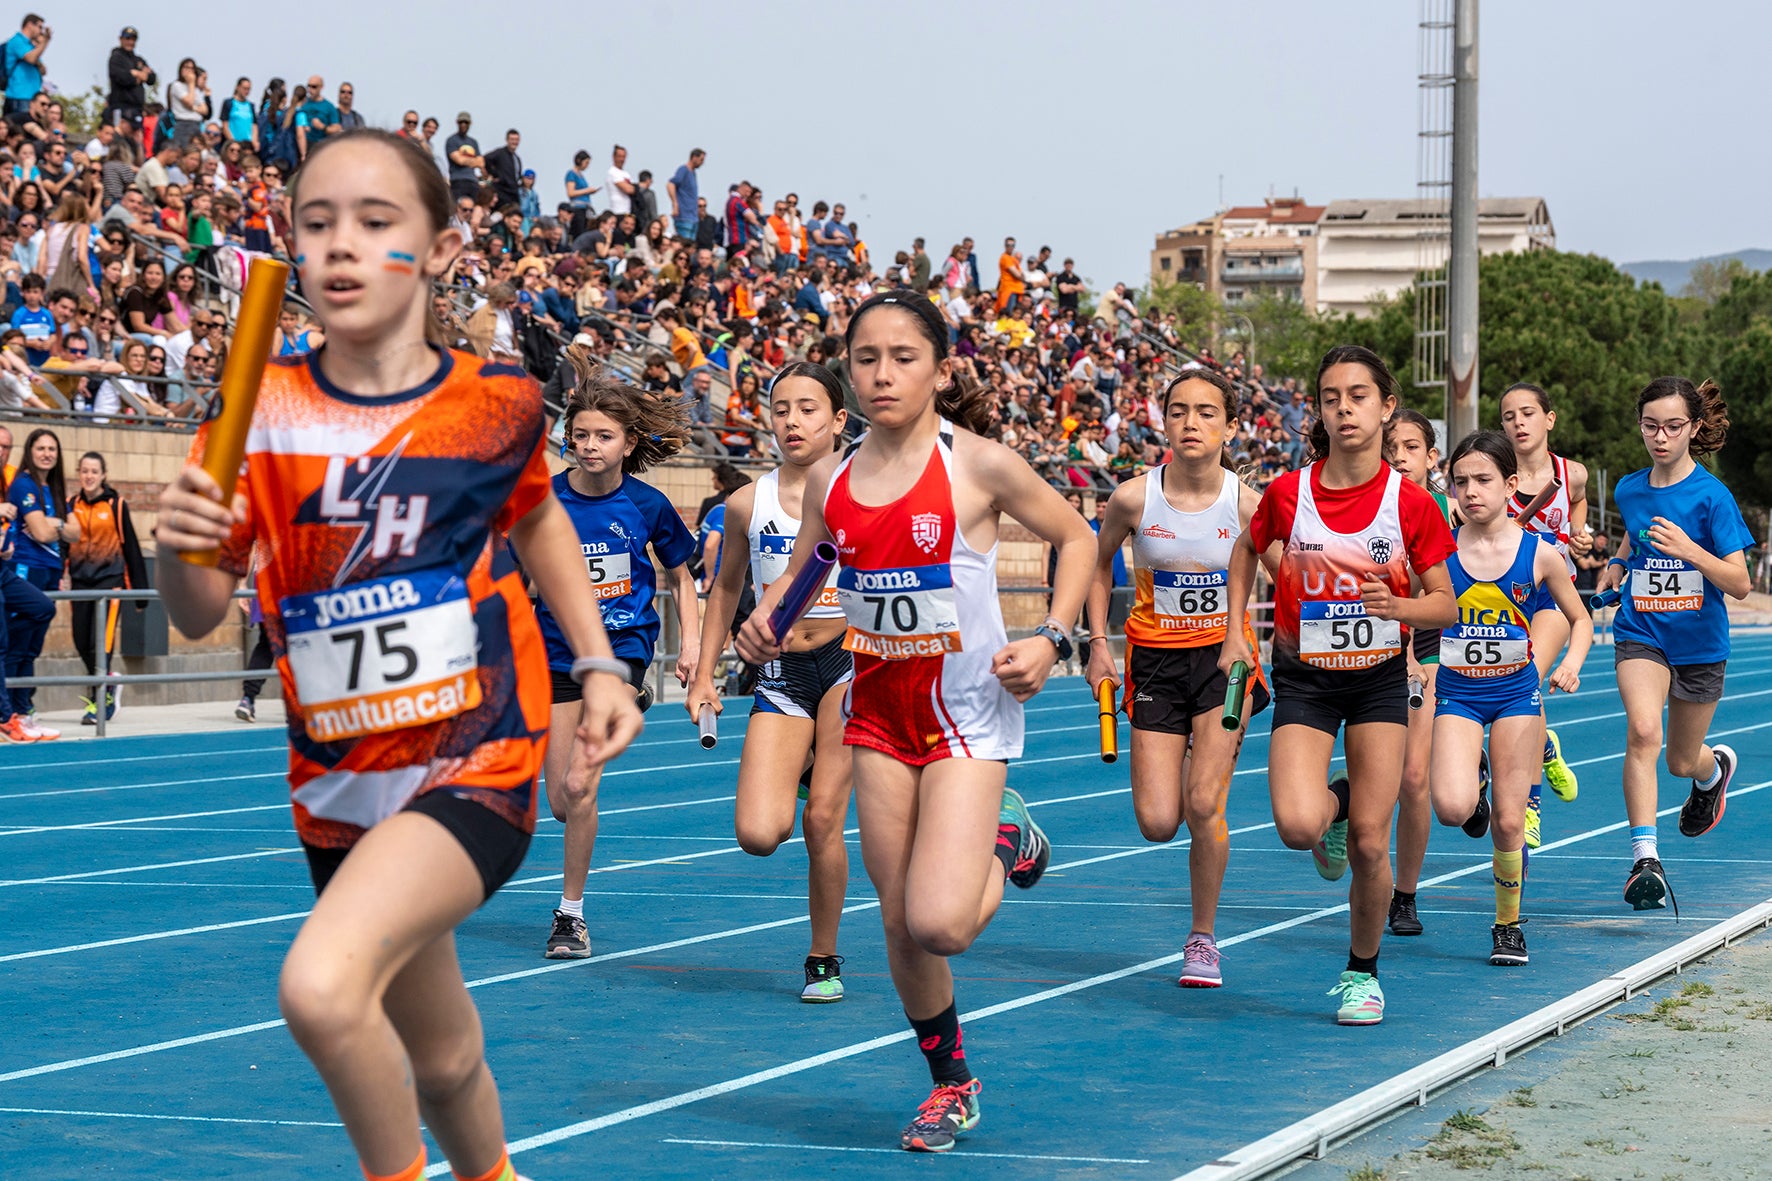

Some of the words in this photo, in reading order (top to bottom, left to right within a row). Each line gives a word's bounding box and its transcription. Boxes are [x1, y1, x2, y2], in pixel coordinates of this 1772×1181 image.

[580, 541, 609, 555] ma
[589, 558, 606, 583] 5
[593, 582, 625, 599] acat
[1649, 572, 1682, 596] 54
[863, 595, 918, 632] 70
[1179, 588, 1219, 614] 68
[1325, 602, 1367, 619] Jom
[1634, 597, 1699, 611] mutuacat
[1160, 616, 1228, 631] mutuaca
[1330, 619, 1374, 650] 50
[331, 620, 418, 692] 75
[852, 632, 953, 659] mutuacat
[1464, 640, 1502, 665] 65
[1308, 650, 1395, 669] mutuacat
[312, 676, 468, 737] mutuacat
